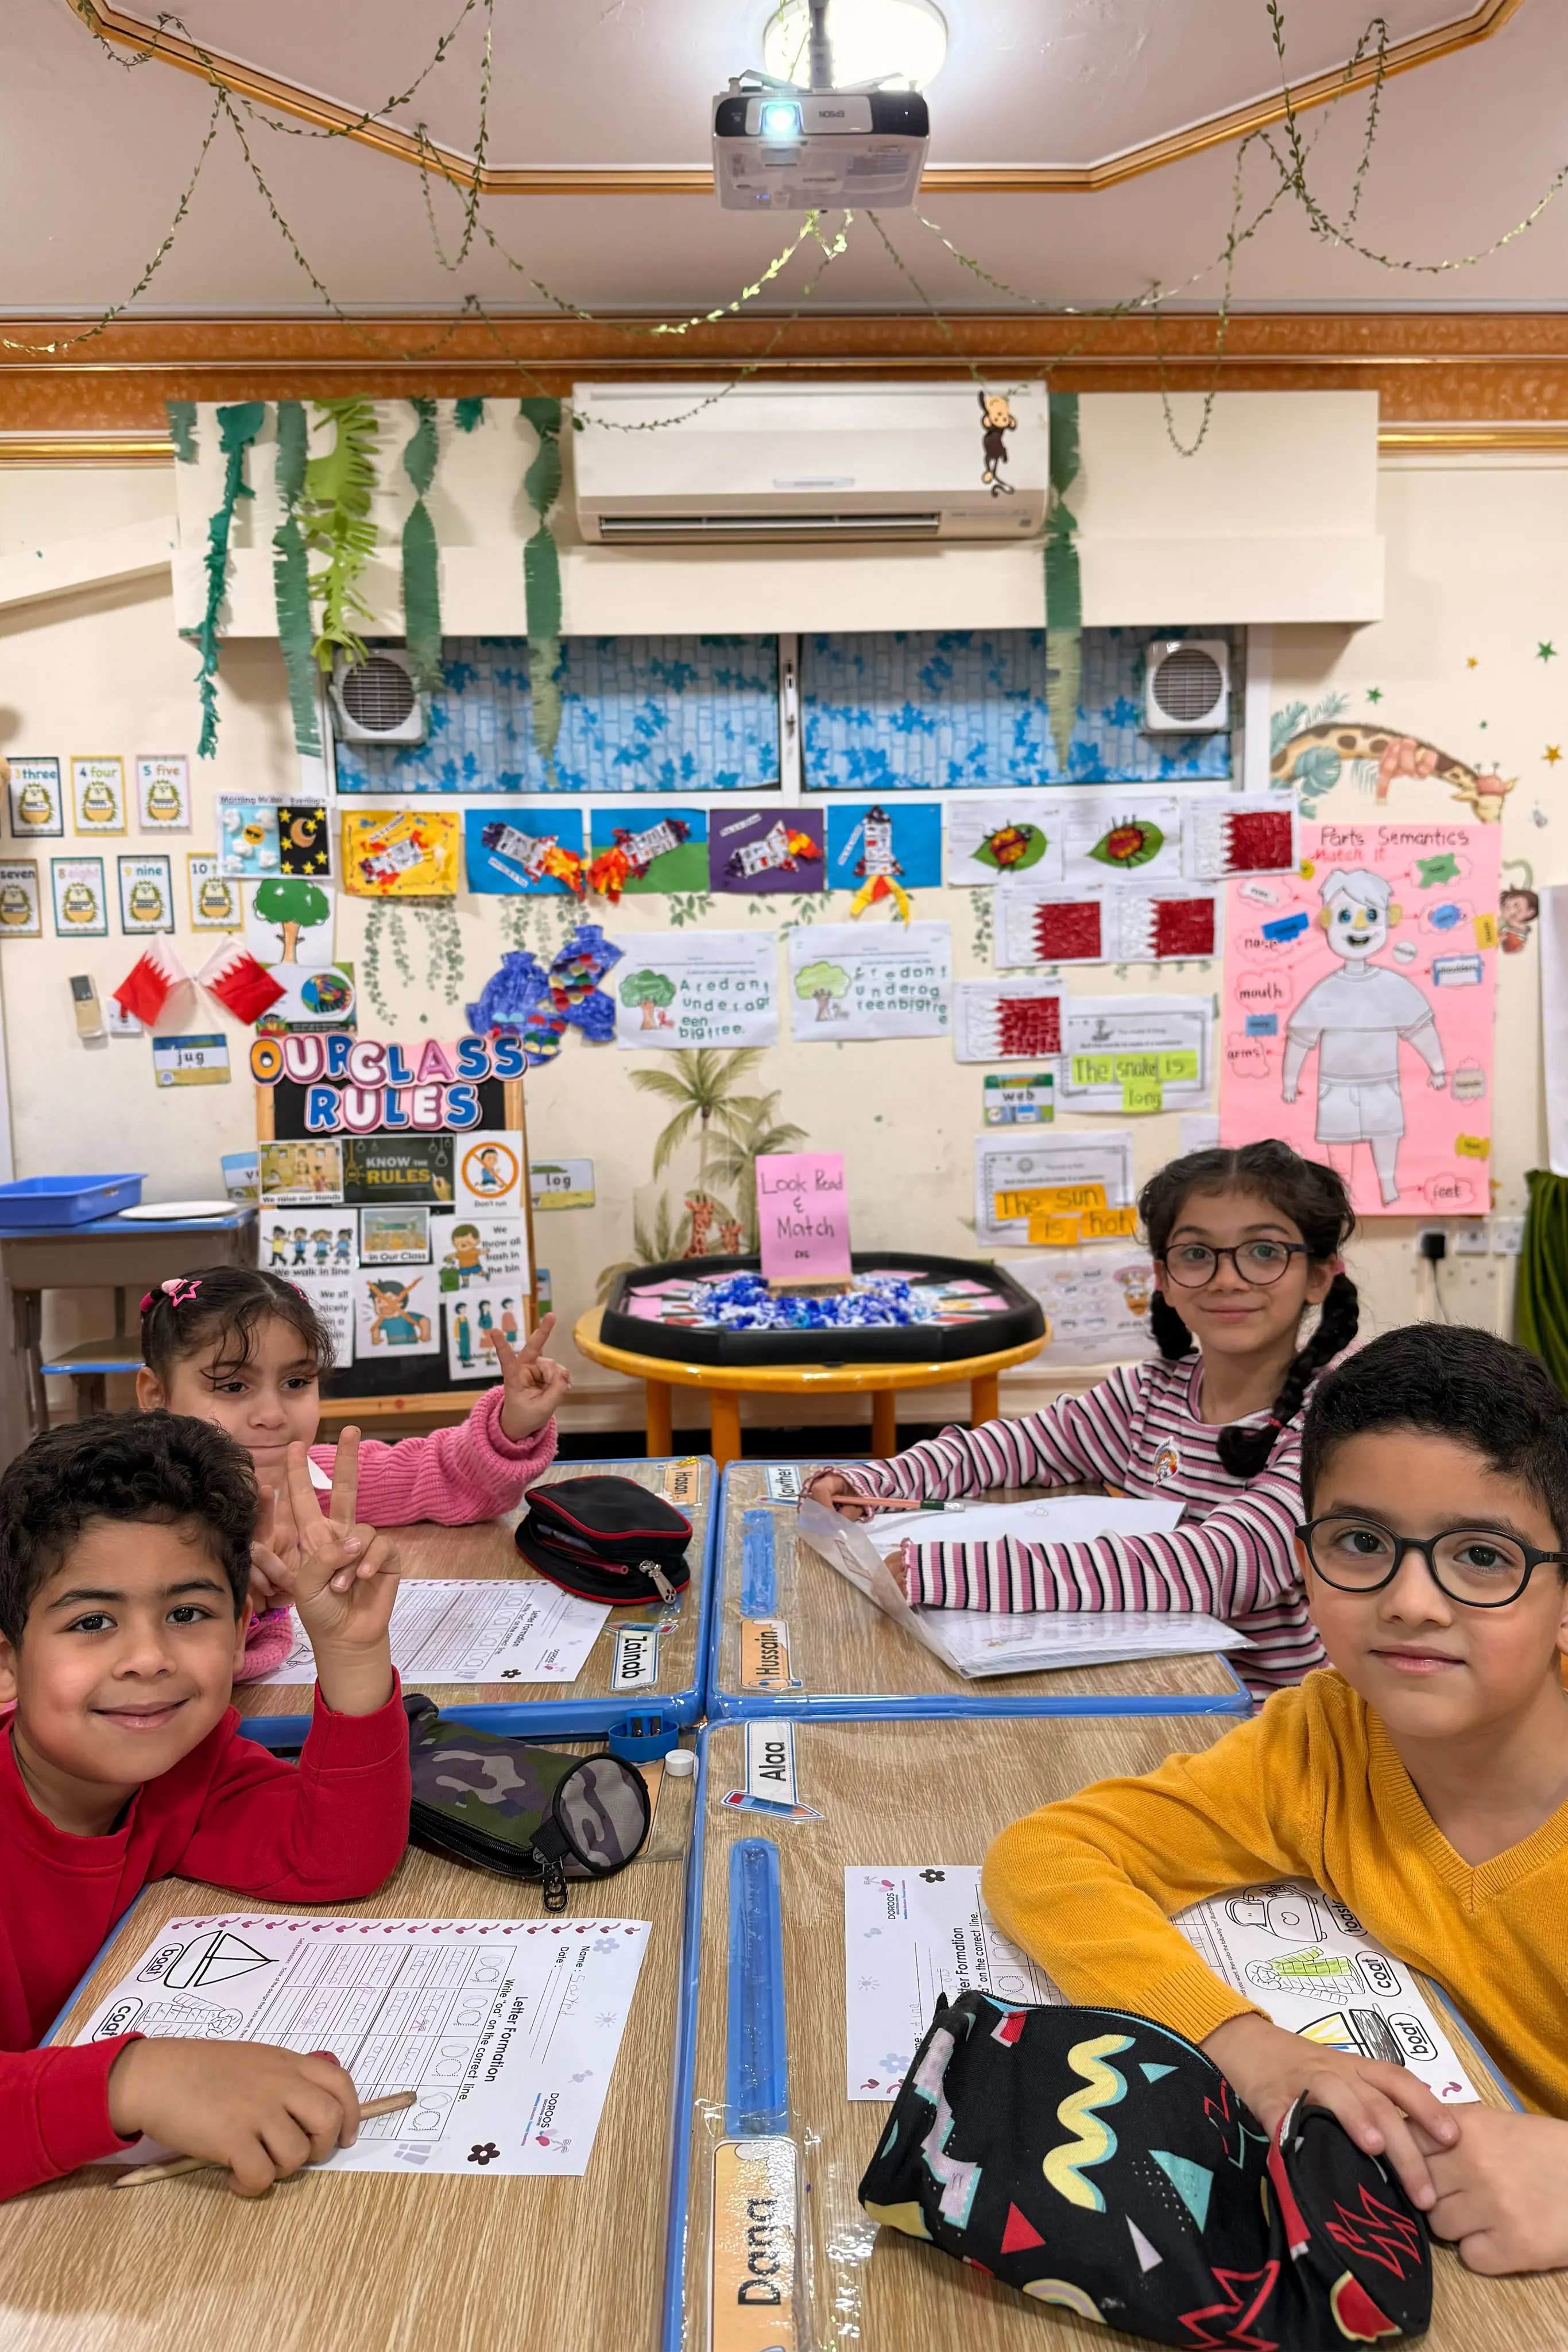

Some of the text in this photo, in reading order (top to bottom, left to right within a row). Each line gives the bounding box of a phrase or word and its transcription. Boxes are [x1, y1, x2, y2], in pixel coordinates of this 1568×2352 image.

[22, 768, 57, 779] three
[80, 766, 118, 777] 4 four
[143, 764, 180, 776] 5 five
[1321, 825, 1470, 846] Parts Semantics
[59, 868, 99, 882] 8 eight
[124, 865, 162, 877] 9 nine
[192, 864, 207, 875] 10
[680, 979, 690, 991] A
[1239, 981, 1283, 1001] mouth
[176, 1050, 204, 1066] jug
[251, 1036, 527, 1088] OUR CLASS
[1075, 1059, 1108, 1082] The
[1116, 1057, 1156, 1077] snake
[1002, 1088, 1035, 1101] web
[1128, 1090, 1162, 1108] long
[307, 1085, 480, 1131] RULES
[366, 1156, 410, 1169] KNOW
[366, 1169, 430, 1185] RULES
[547, 1173, 571, 1189] log
[761, 1169, 843, 1194] Look Read
[1001, 1192, 1040, 1215] The
[493, 1226, 507, 1234] We
[777, 1215, 834, 1238] Match
[510, 1237, 521, 1245] all
[381, 1252, 398, 1261] Our
[402, 1251, 426, 1260] Class
[486, 1252, 508, 1262] trash
[293, 1267, 316, 1276] walk
[332, 1266, 350, 1275] line
[505, 1264, 520, 1272] bin
[320, 1290, 335, 1298] We
[674, 1471, 693, 1494] Hasan
[778, 1468, 795, 1498] Kawther
[622, 1636, 648, 1678] Zainab
[756, 1627, 779, 1676] Hussain
[760, 1740, 786, 1782] Alaa
[888, 1893, 896, 1920] DOROOS
[969, 1912, 980, 1927] line.
[951, 1927, 969, 1975] Formation
[970, 1931, 982, 1955] correct
[146, 1949, 179, 1974] boat
[556, 1947, 569, 1964] Date
[576, 1946, 590, 1968] Name
[975, 1957, 985, 1971] the
[979, 1972, 988, 1982] on
[1361, 1958, 1392, 1989] coat
[500, 1979, 515, 1998] Write
[102, 2006, 131, 2036] coat
[486, 2020, 497, 2030] on
[481, 2032, 494, 2046] the
[484, 1997, 528, 2082] Letter Formation
[1395, 2021, 1429, 2055] boat
[467, 2048, 486, 2079] correct
[458, 2083, 475, 2102] line.
[541, 2092, 560, 2128] DOROOS
[737, 2198, 782, 2305] Dana
